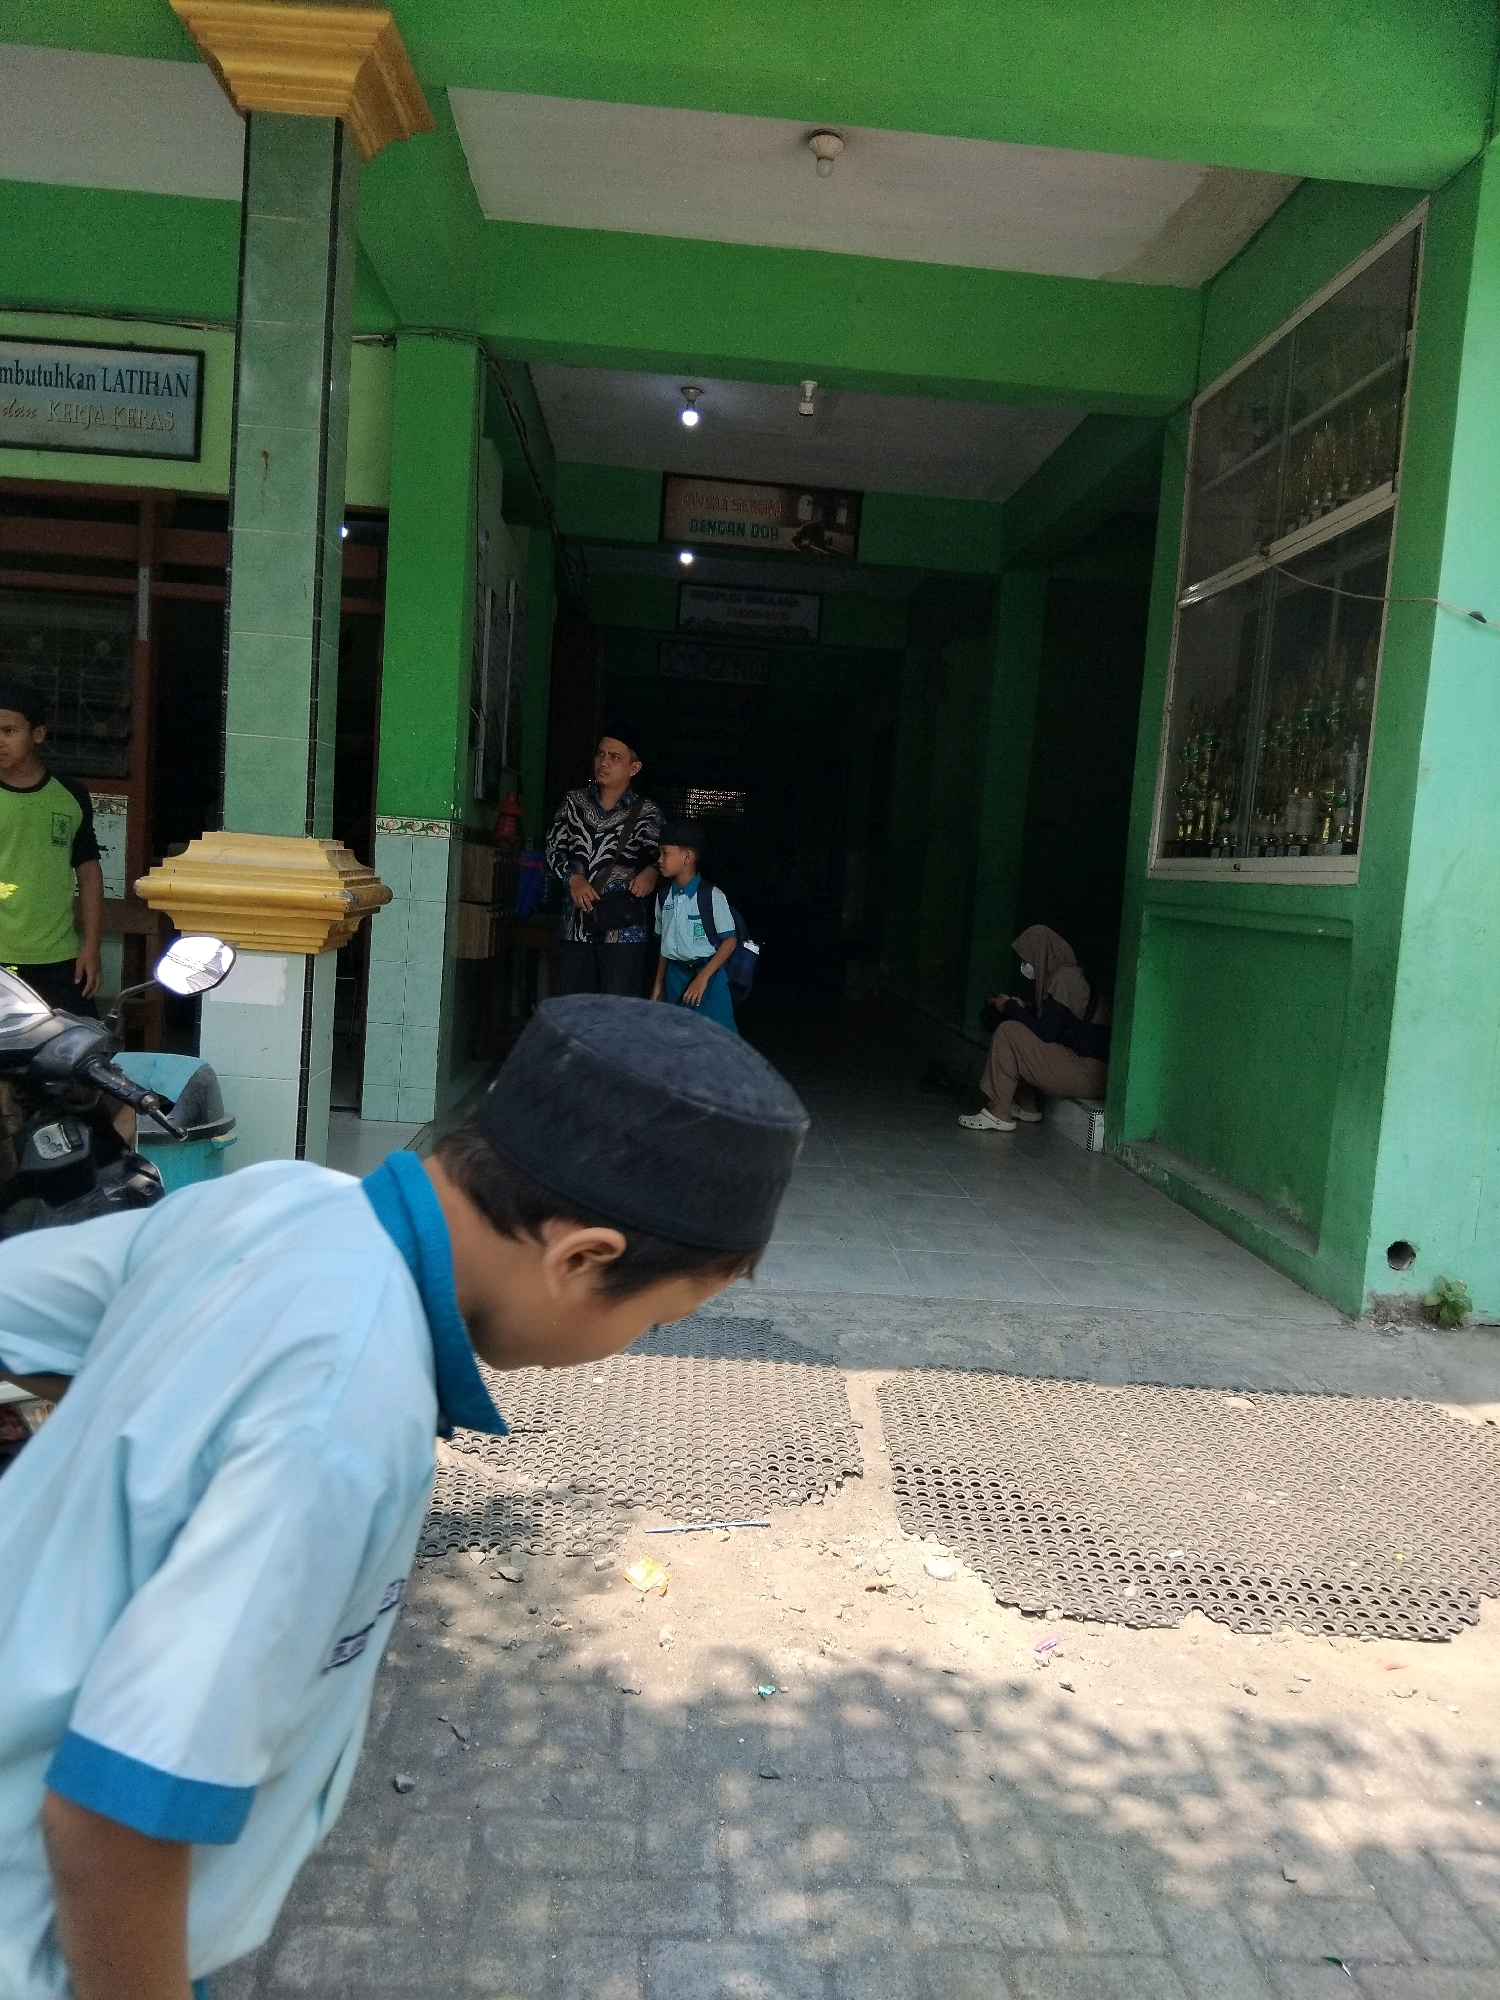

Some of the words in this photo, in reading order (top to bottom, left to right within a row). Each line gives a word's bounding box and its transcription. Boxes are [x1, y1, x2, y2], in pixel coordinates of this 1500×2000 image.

[102, 367, 189, 398] LATIHAN
[2, 399, 37, 419] dan
[47, 400, 106, 430] KERJA
[112, 406, 175, 431] KERAS
[690, 519, 745, 536] DENGAN
[751, 524, 779, 540] DOA
